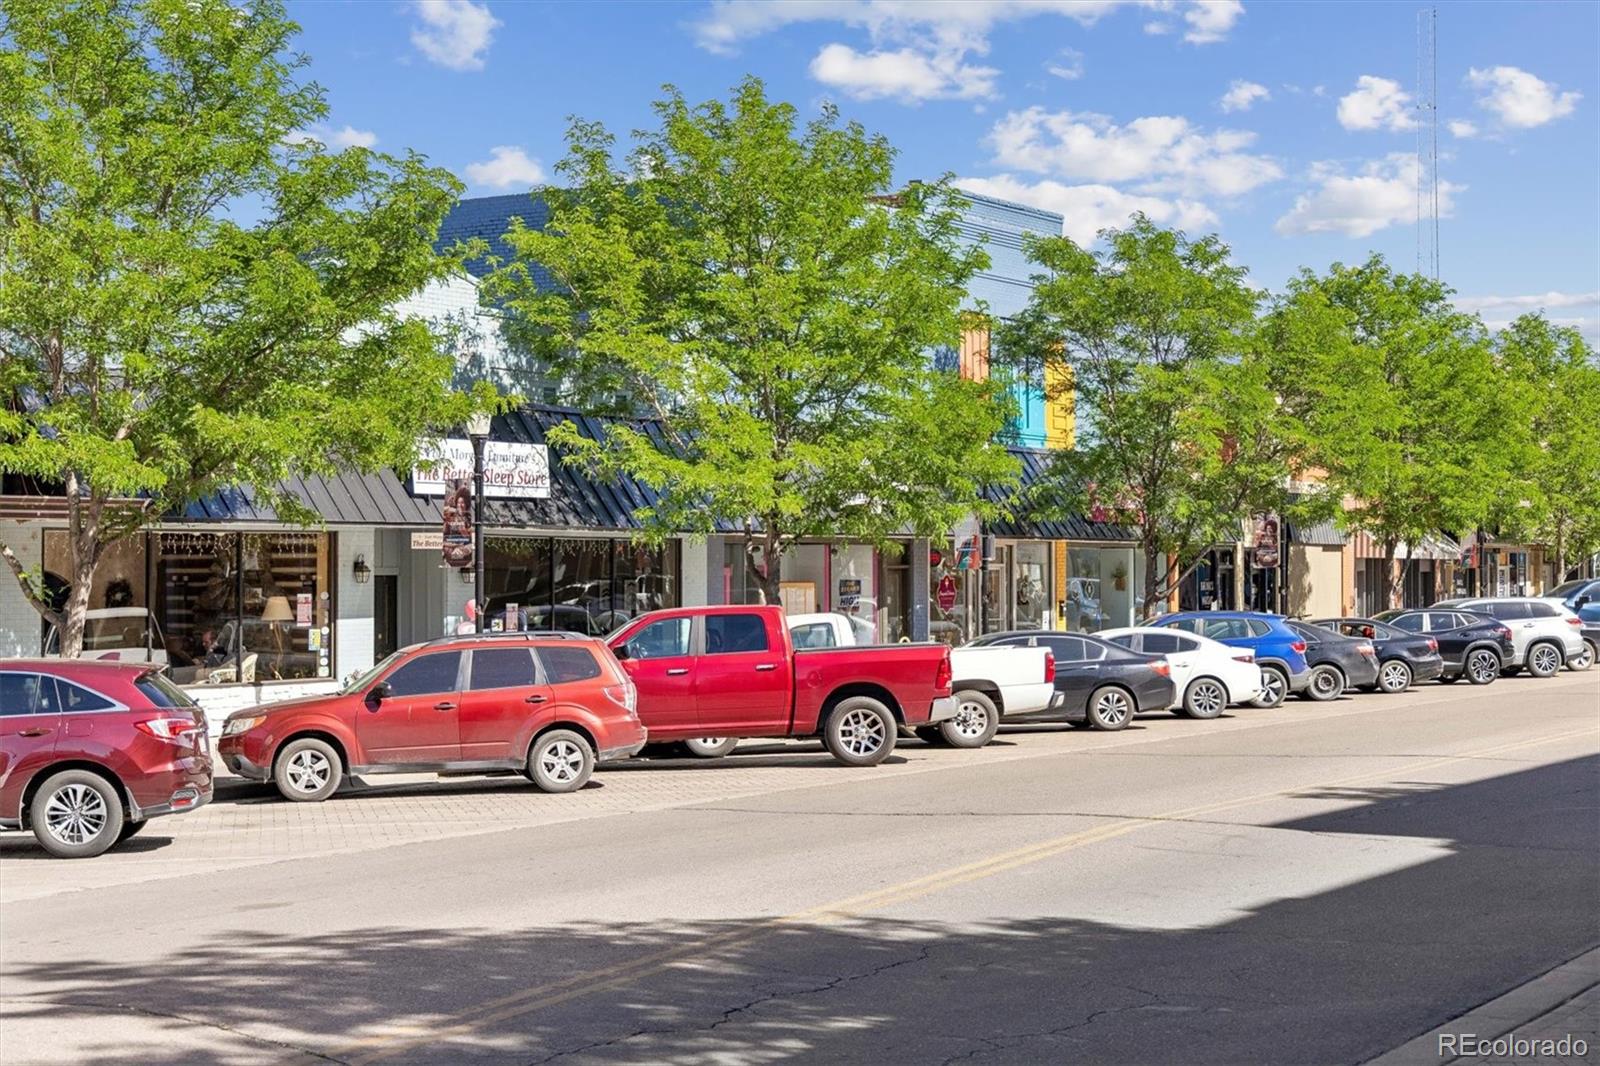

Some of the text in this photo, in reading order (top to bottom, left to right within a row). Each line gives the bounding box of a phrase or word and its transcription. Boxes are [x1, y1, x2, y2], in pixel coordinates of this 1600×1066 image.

[442, 466, 476, 480] Bette
[483, 468, 514, 488] Sleep
[516, 470, 548, 486] Store
